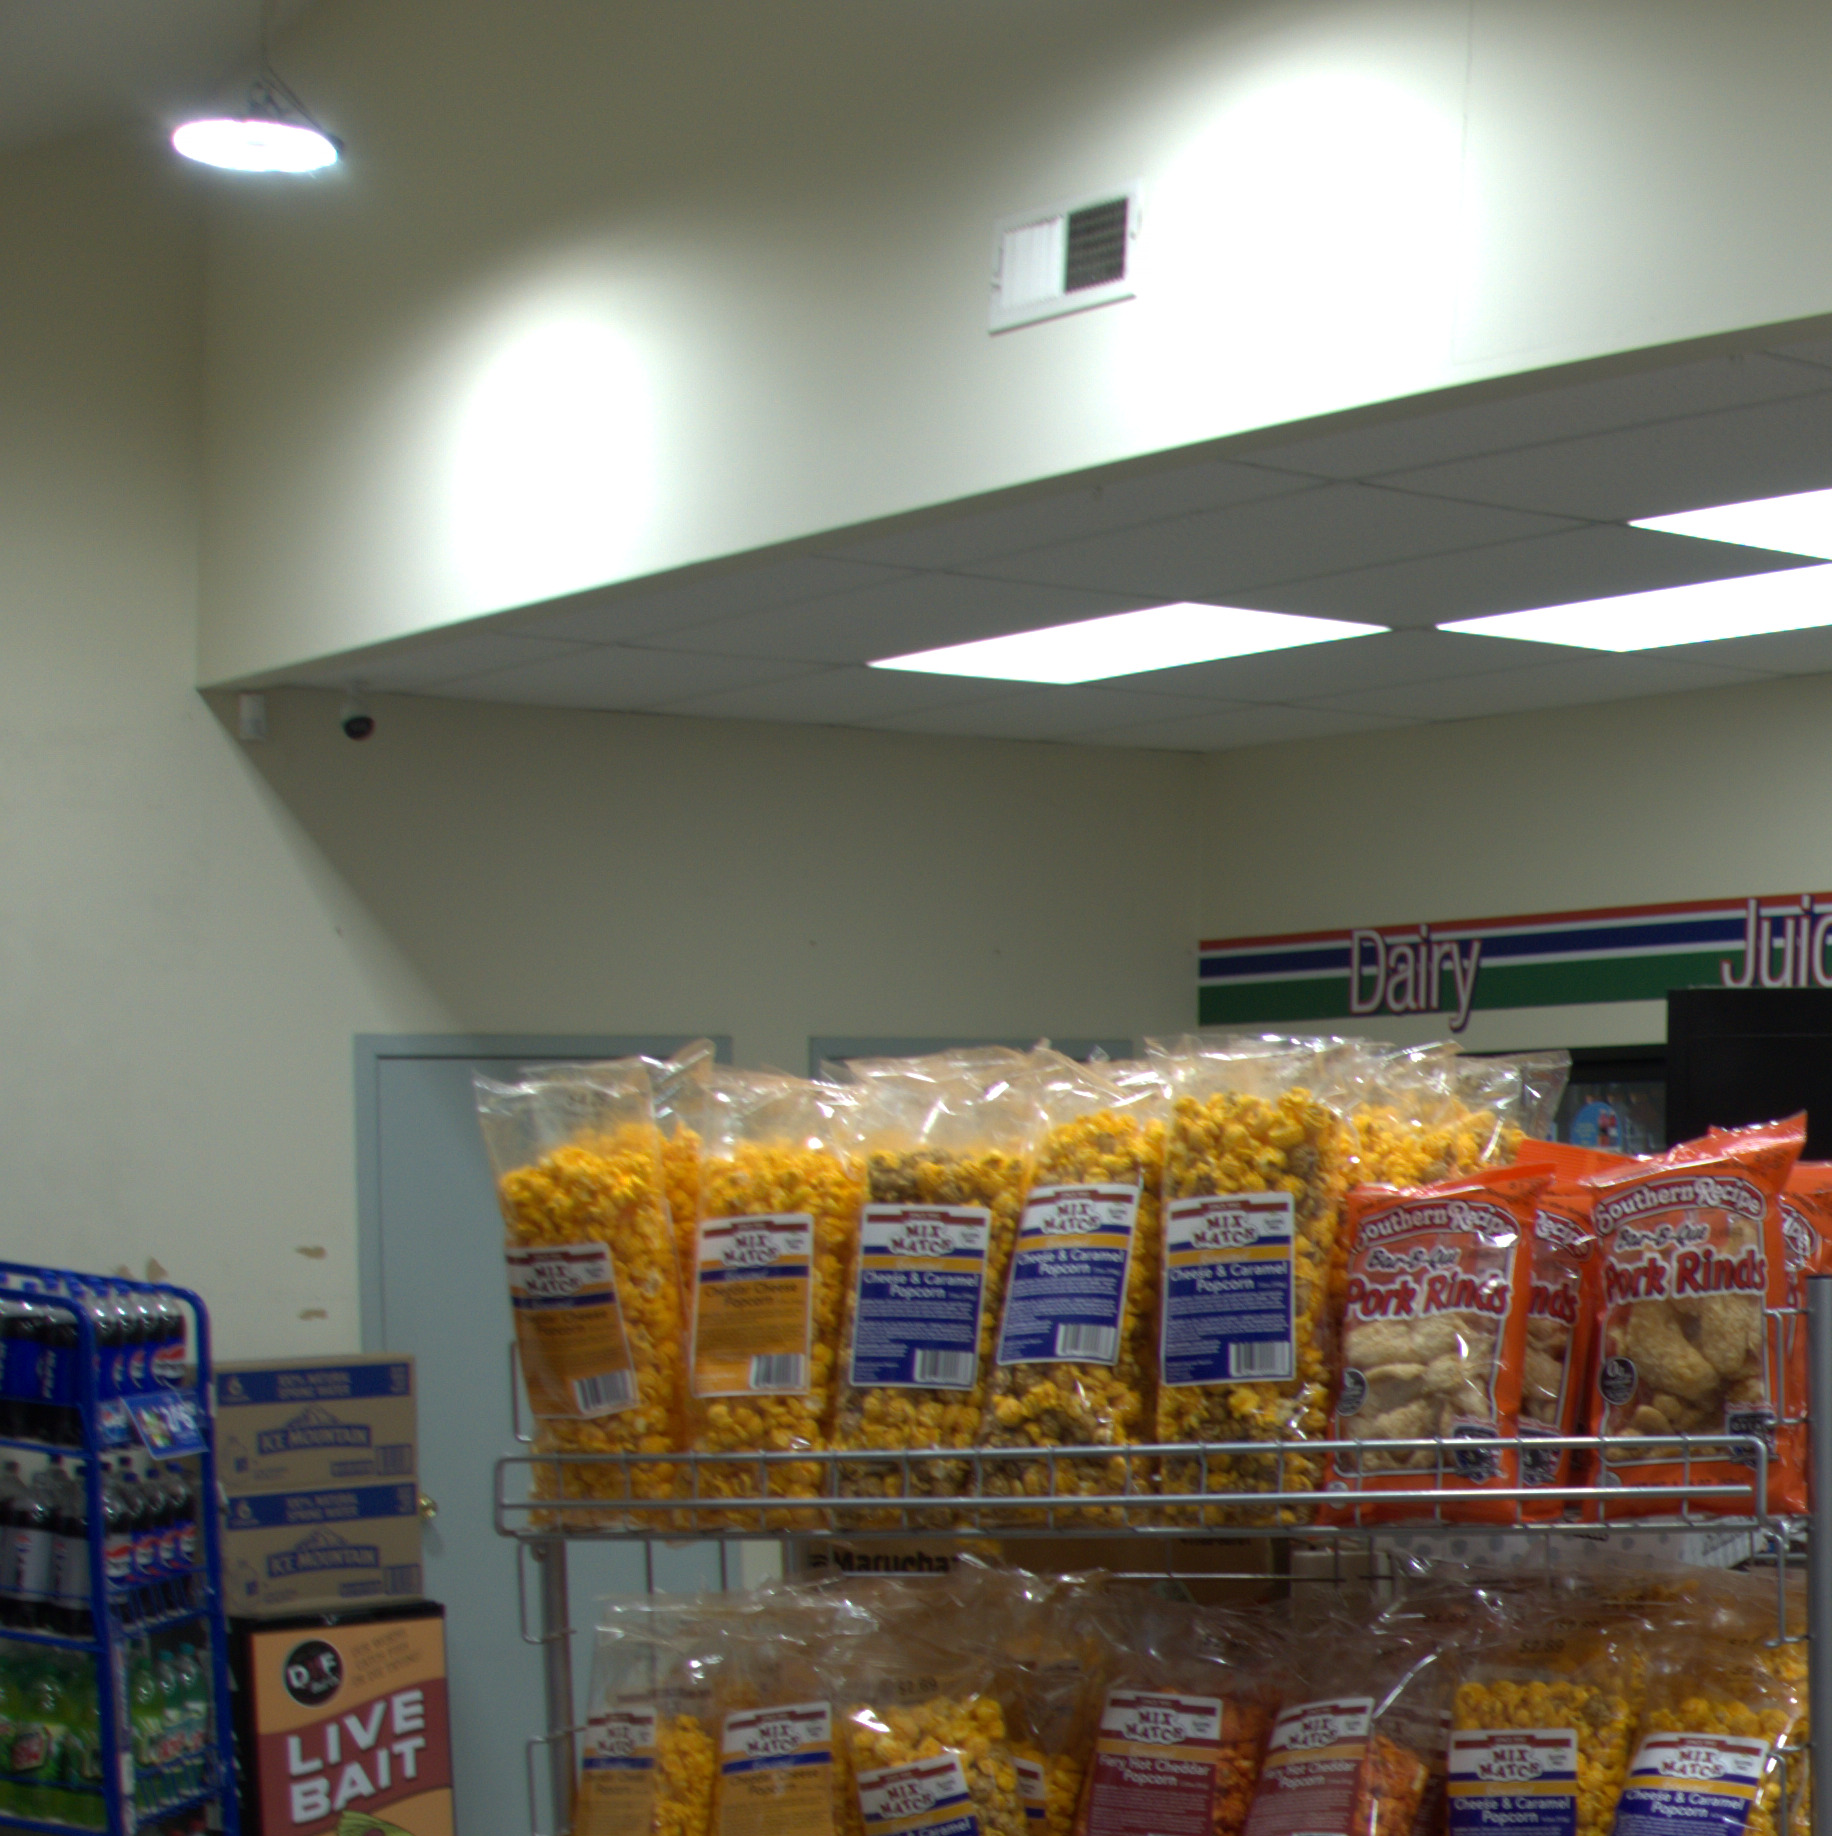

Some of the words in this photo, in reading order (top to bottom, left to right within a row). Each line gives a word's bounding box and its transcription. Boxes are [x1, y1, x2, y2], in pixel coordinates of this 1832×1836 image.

[1348, 925, 1483, 1032] Dairy
[1595, 1182, 1693, 1234] Southern
[1695, 1177, 1763, 1216] Recipe
[906, 1224, 939, 1239] MIX
[1207, 1215, 1241, 1230] MIX
[1354, 1206, 1449, 1254] Southern
[1449, 1201, 1520, 1247] Recipe
[863, 1272, 907, 1286] Cheese
[911, 1272, 920, 1286] &
[924, 1274, 979, 1287] Caramel
[1169, 1265, 1212, 1281] Cheese
[1215, 1264, 1227, 1277] &
[1230, 1262, 1288, 1277] Caramel
[1604, 1263, 1665, 1300] Pork
[1676, 1251, 1766, 1294] Rinds
[890, 1285, 946, 1299] Popcorn
[1195, 1277, 1254, 1293] Popcorn
[1348, 1278, 1416, 1316] Pork
[1428, 1274, 1510, 1312] Rinds
[291, 1426, 370, 1446] MOUNTAIN
[299, 1547, 379, 1568] MOUNTAIN
[833, 1552, 961, 1572] Marucha
[1139, 1708, 1174, 1725] MIX
[287, 1689, 426, 1776] LIVE
[289, 1737, 427, 1824] BAIT
[1123, 1770, 1178, 1786] Popcorn
